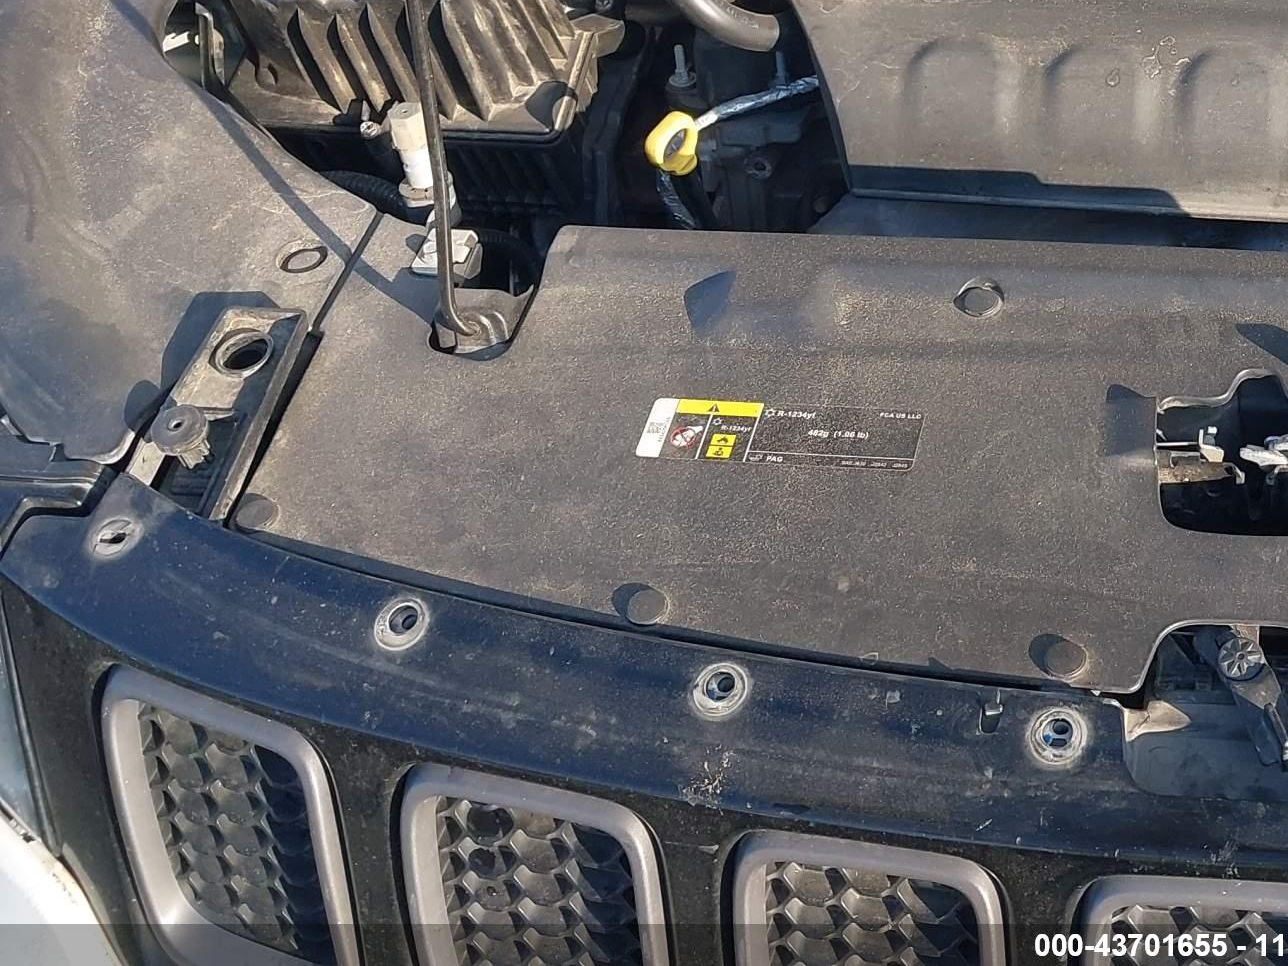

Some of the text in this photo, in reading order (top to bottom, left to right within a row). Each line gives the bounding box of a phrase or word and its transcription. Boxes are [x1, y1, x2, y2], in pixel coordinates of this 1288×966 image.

[776, 410, 817, 420] R-1234yf
[720, 424, 752, 433] R-1234yf
[857, 431, 869, 440] lb)
[766, 455, 783, 463] PAG
